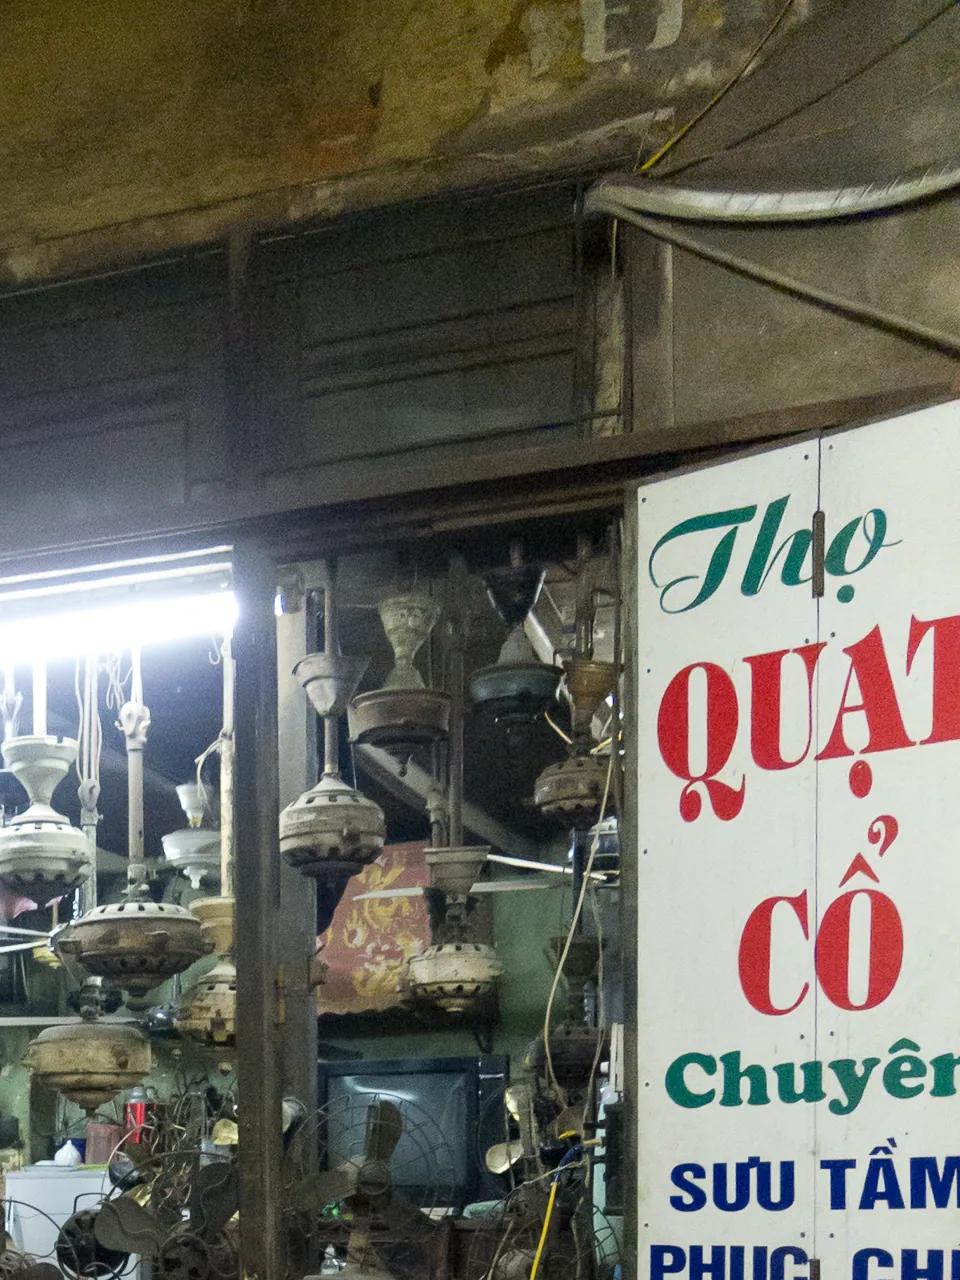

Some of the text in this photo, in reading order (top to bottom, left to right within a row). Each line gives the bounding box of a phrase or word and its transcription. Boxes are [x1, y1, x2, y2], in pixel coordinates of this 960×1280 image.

[738, 815, 904, 1016] CỔ
[669, 1137, 960, 1212] SƯU TẦM
